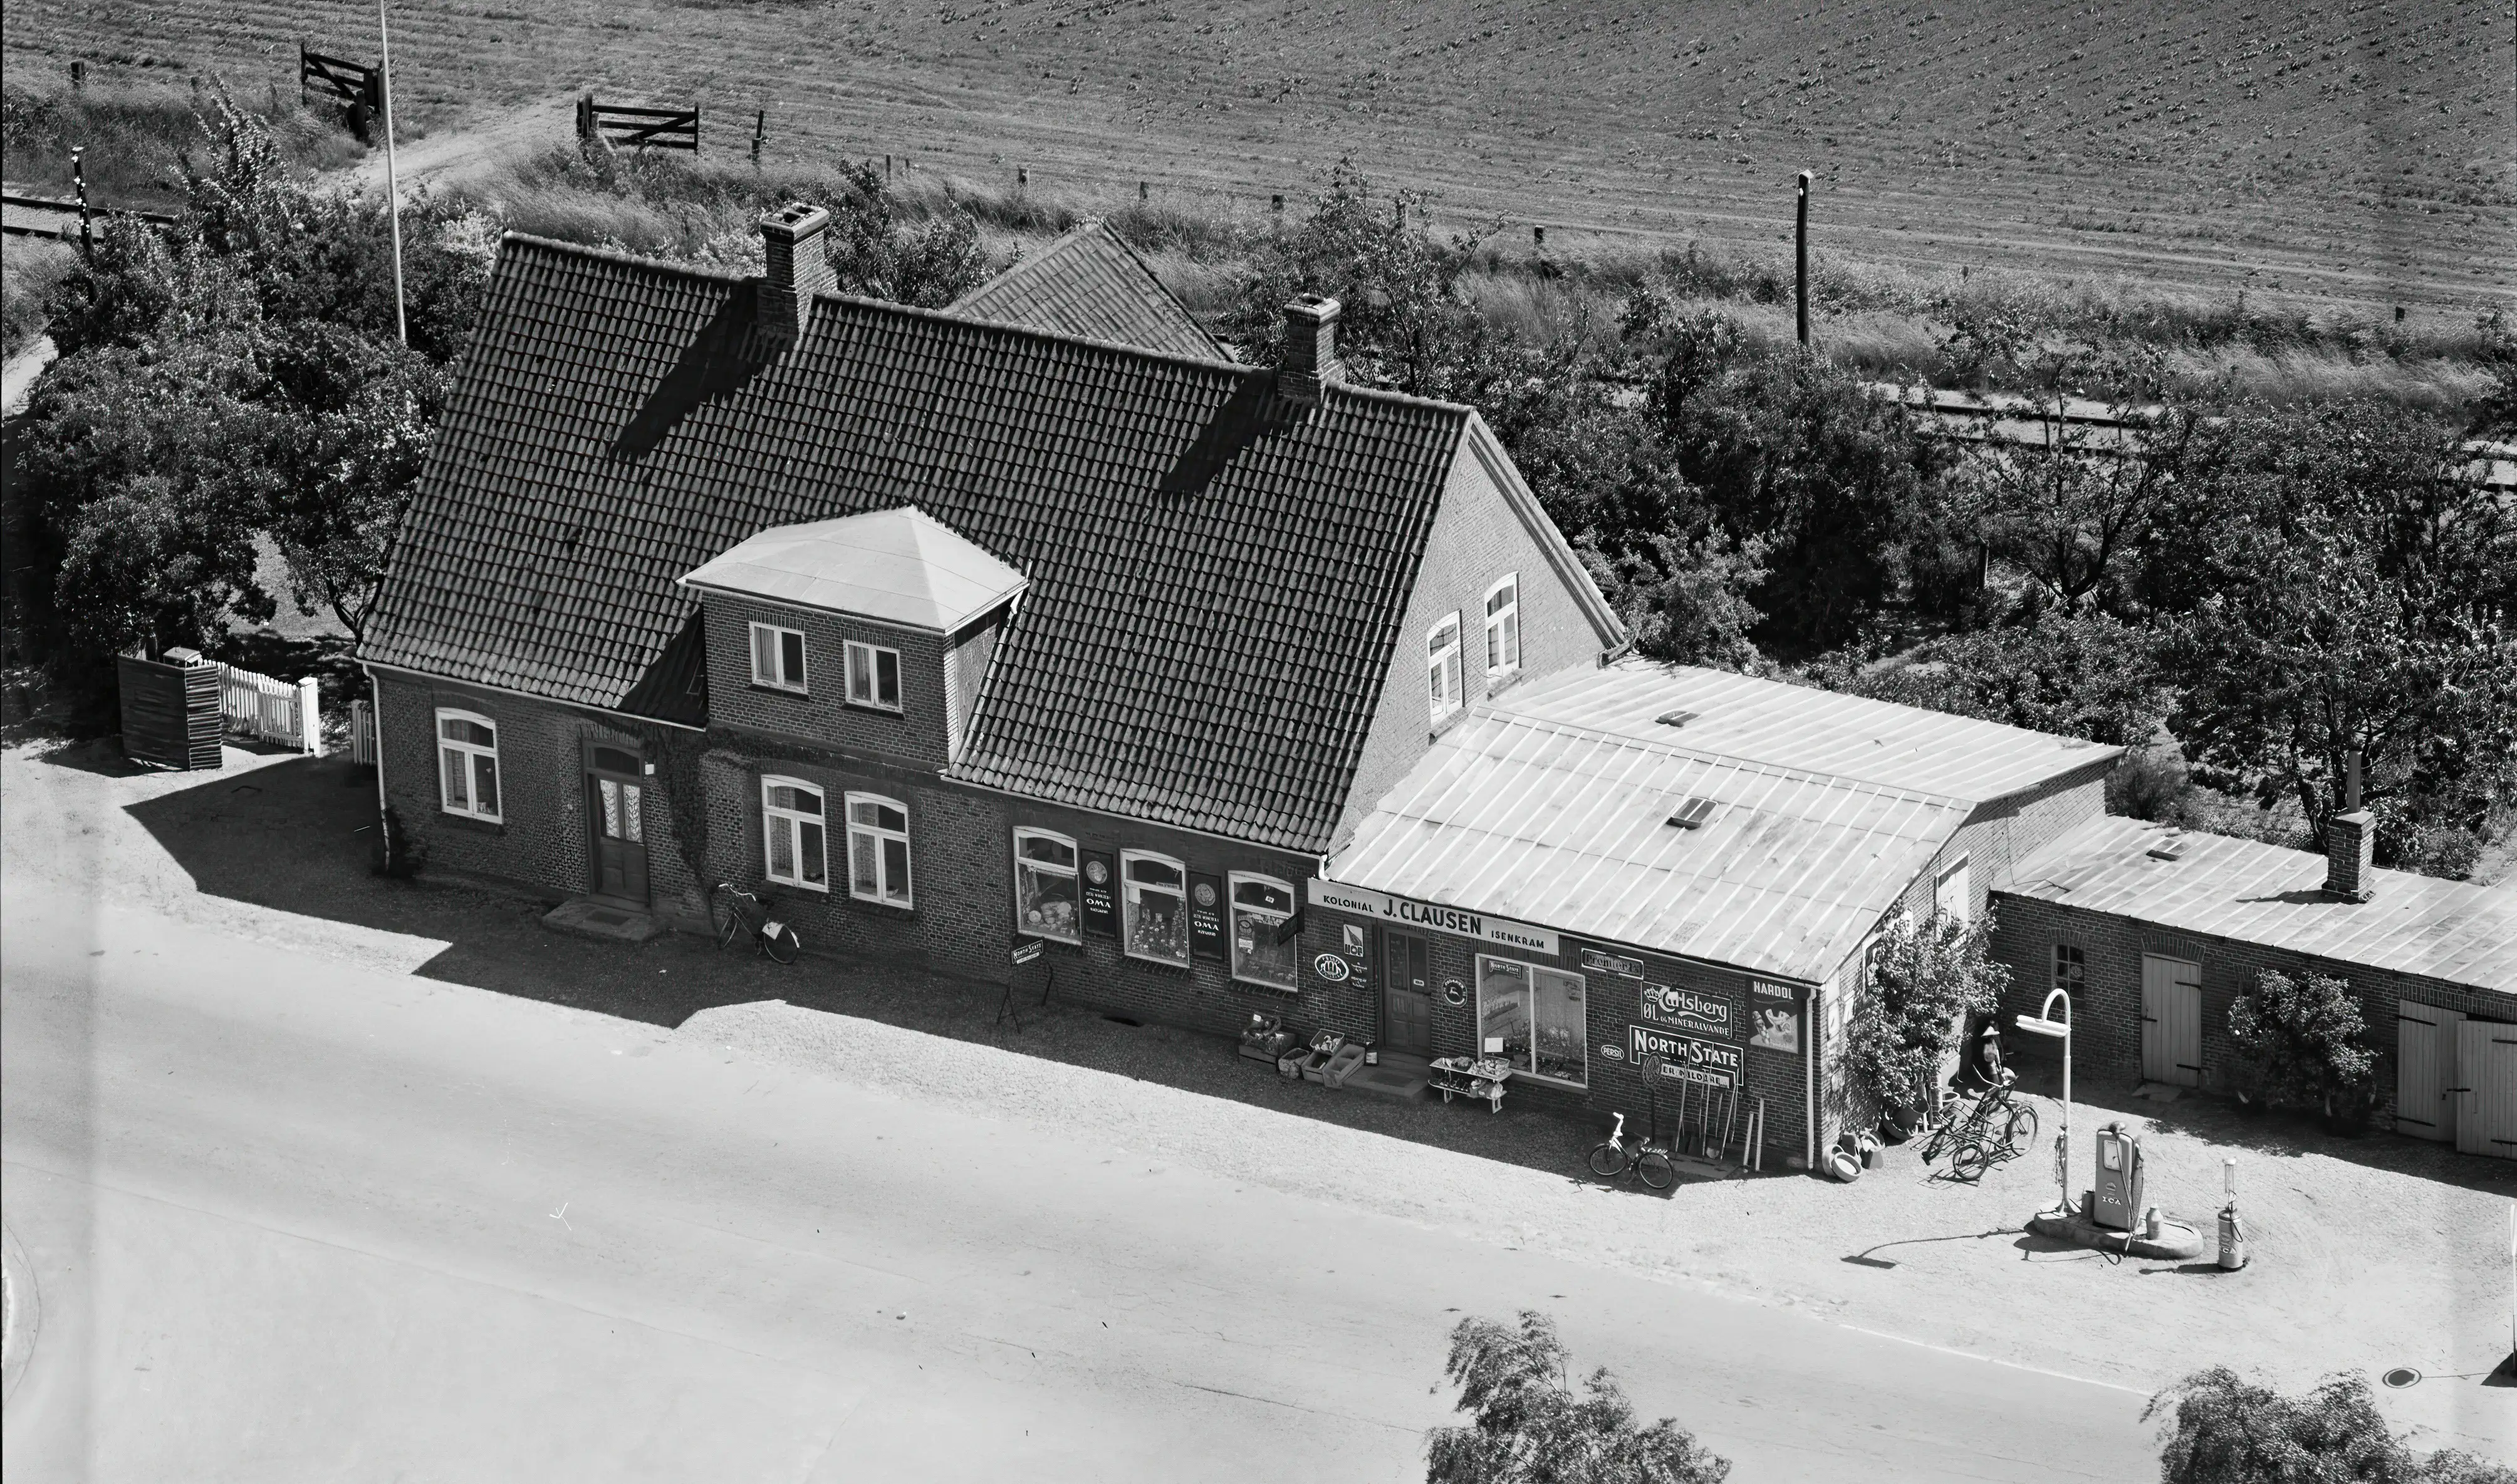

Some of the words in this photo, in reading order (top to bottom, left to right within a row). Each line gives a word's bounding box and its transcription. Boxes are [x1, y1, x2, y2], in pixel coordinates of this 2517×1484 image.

[1086, 898, 1111, 908] OMA
[1194, 921, 1219, 931] OMA
[1323, 895, 1374, 913] KOLONIAL
[1492, 930, 1545, 948] ISENKRAM
[1644, 1002, 1659, 1021] ØL
[1668, 1016, 1729, 1035] MINERALVANDE
[1659, 986, 1727, 1022] Carlsberg
[1603, 1047, 1622, 1058] PERSIL
[1635, 1029, 1687, 1057] NORTH
[1691, 1042, 1738, 1067] STATE
